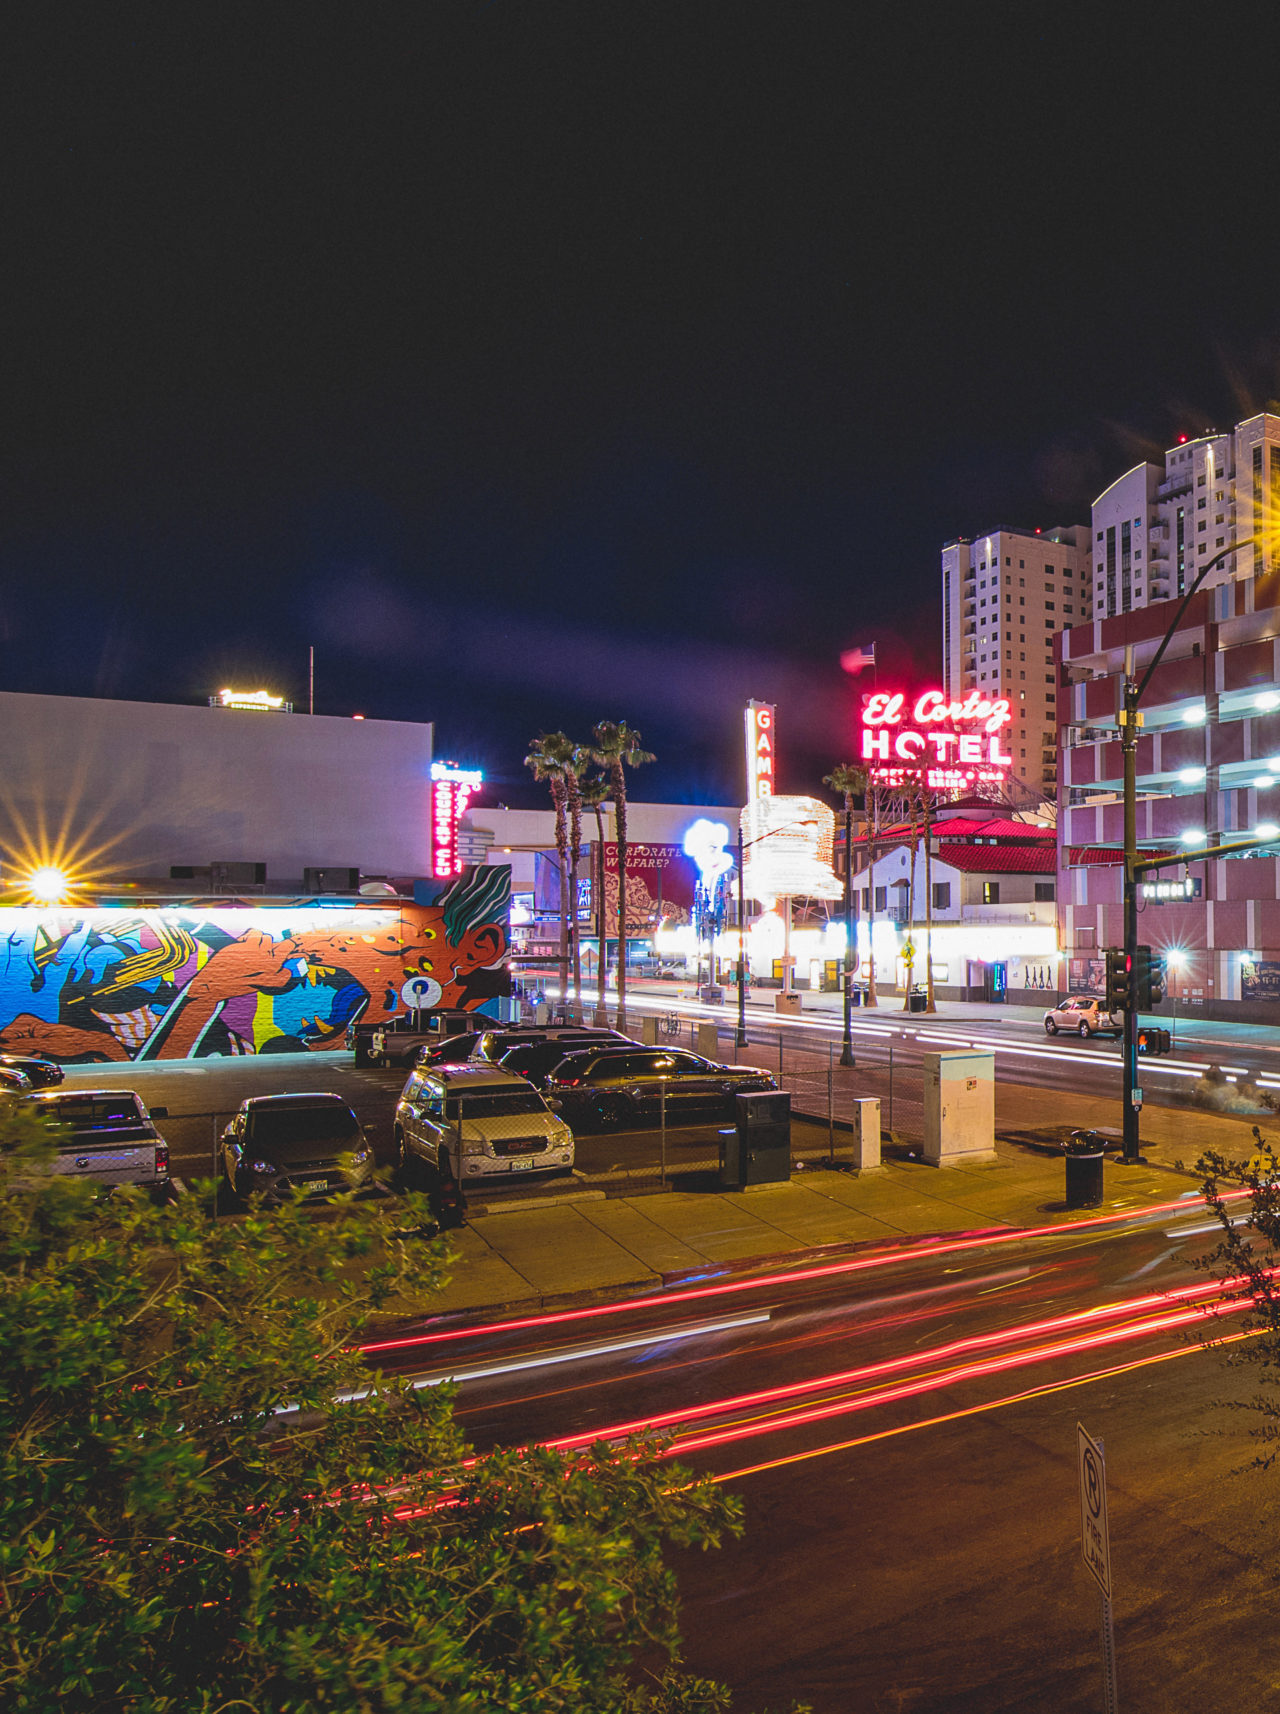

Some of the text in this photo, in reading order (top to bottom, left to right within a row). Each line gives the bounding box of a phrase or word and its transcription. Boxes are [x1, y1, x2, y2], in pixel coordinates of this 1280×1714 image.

[862, 690, 1011, 733] El Cortez
[862, 729, 1012, 765] HOTEL
[606, 857, 670, 868] WLFARE?
